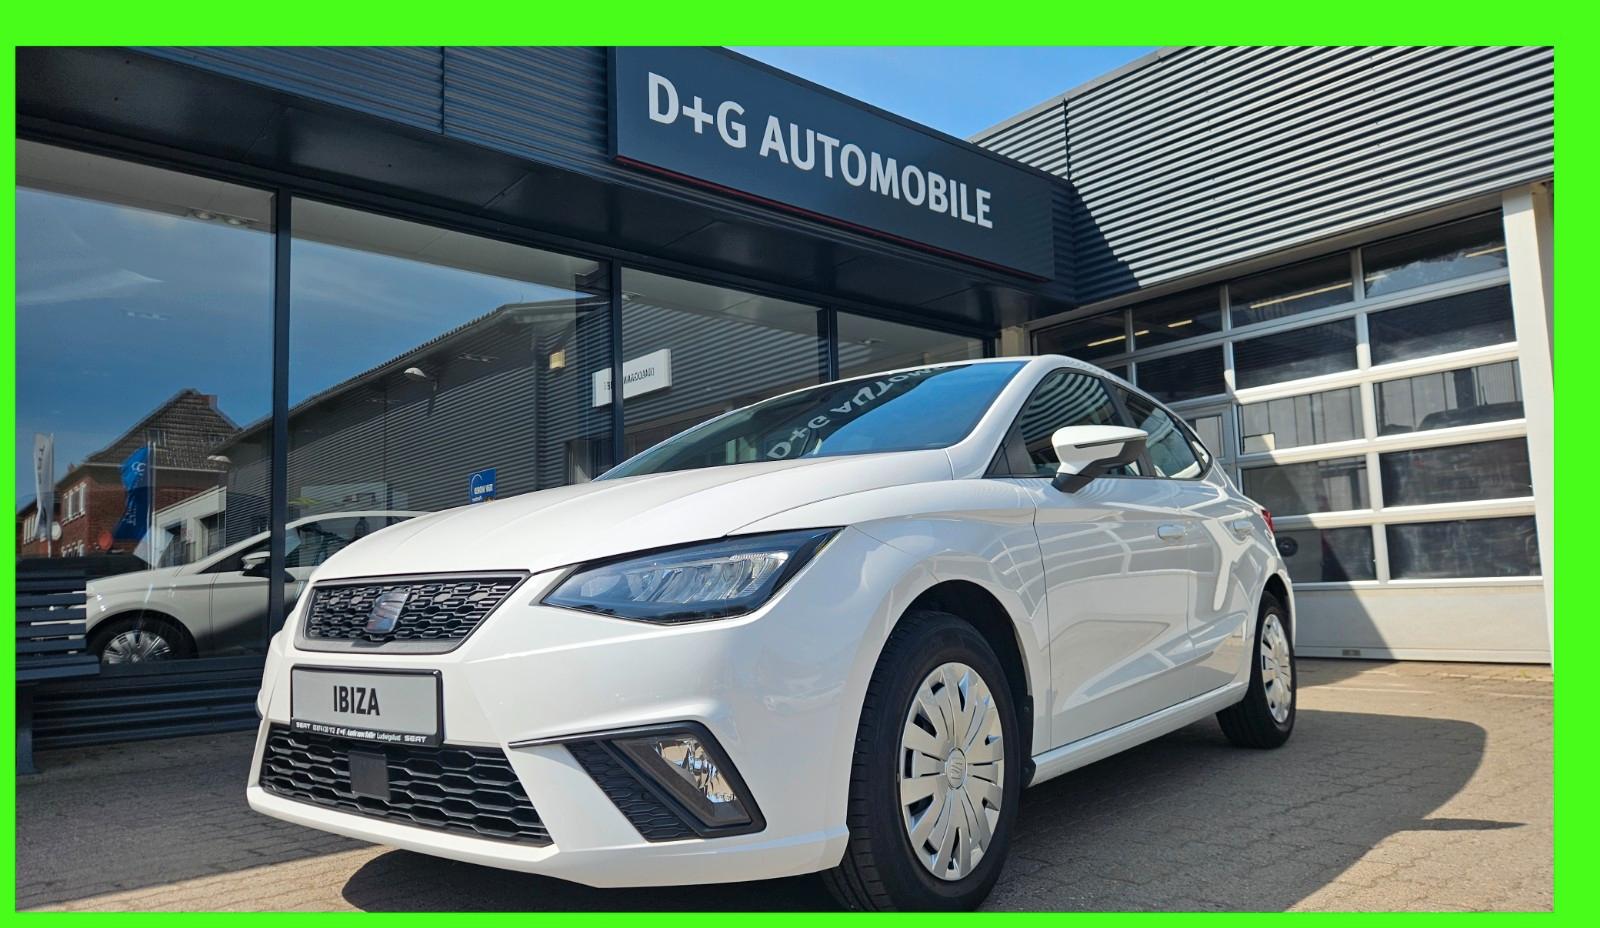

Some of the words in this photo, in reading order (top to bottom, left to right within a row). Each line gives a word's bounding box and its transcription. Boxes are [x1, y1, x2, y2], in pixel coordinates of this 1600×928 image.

[648, 71, 747, 149] D+G
[759, 115, 994, 229] AUTOMOBILE
[333, 685, 380, 716] IBIZA
